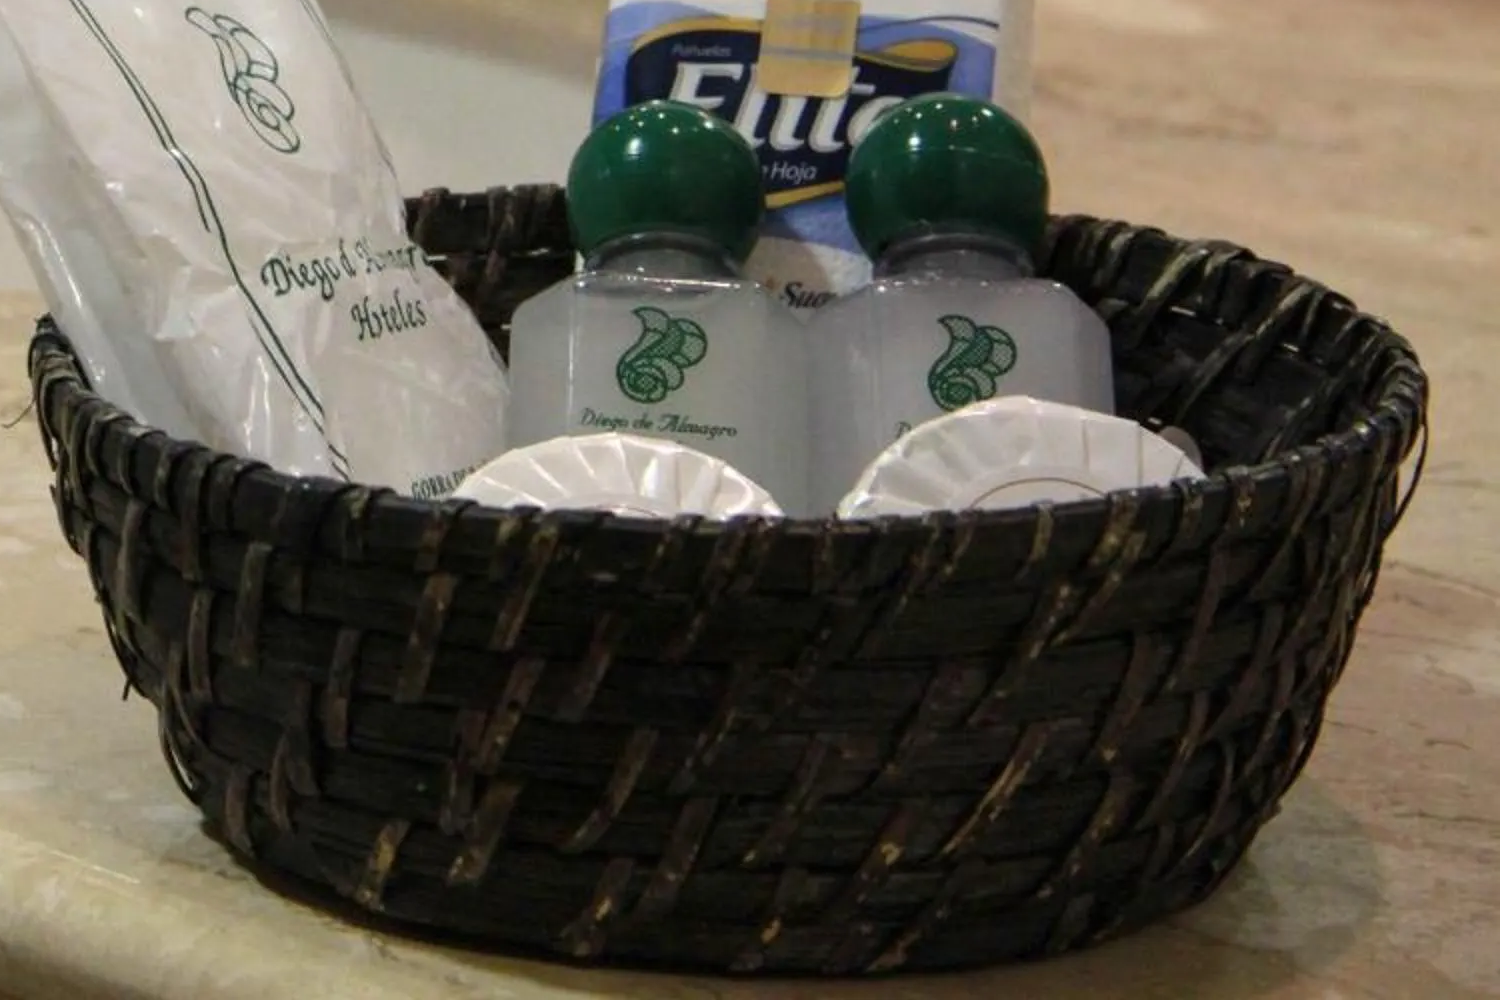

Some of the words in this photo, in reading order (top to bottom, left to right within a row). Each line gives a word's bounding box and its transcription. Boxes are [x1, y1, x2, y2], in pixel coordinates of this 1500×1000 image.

[770, 160, 818, 183] Hoja
[260, 254, 341, 302] Diego
[351, 288, 428, 341] Hoteles
[581, 407, 628, 431] Diego
[632, 412, 653, 429] de
[658, 413, 737, 440] Almagro
